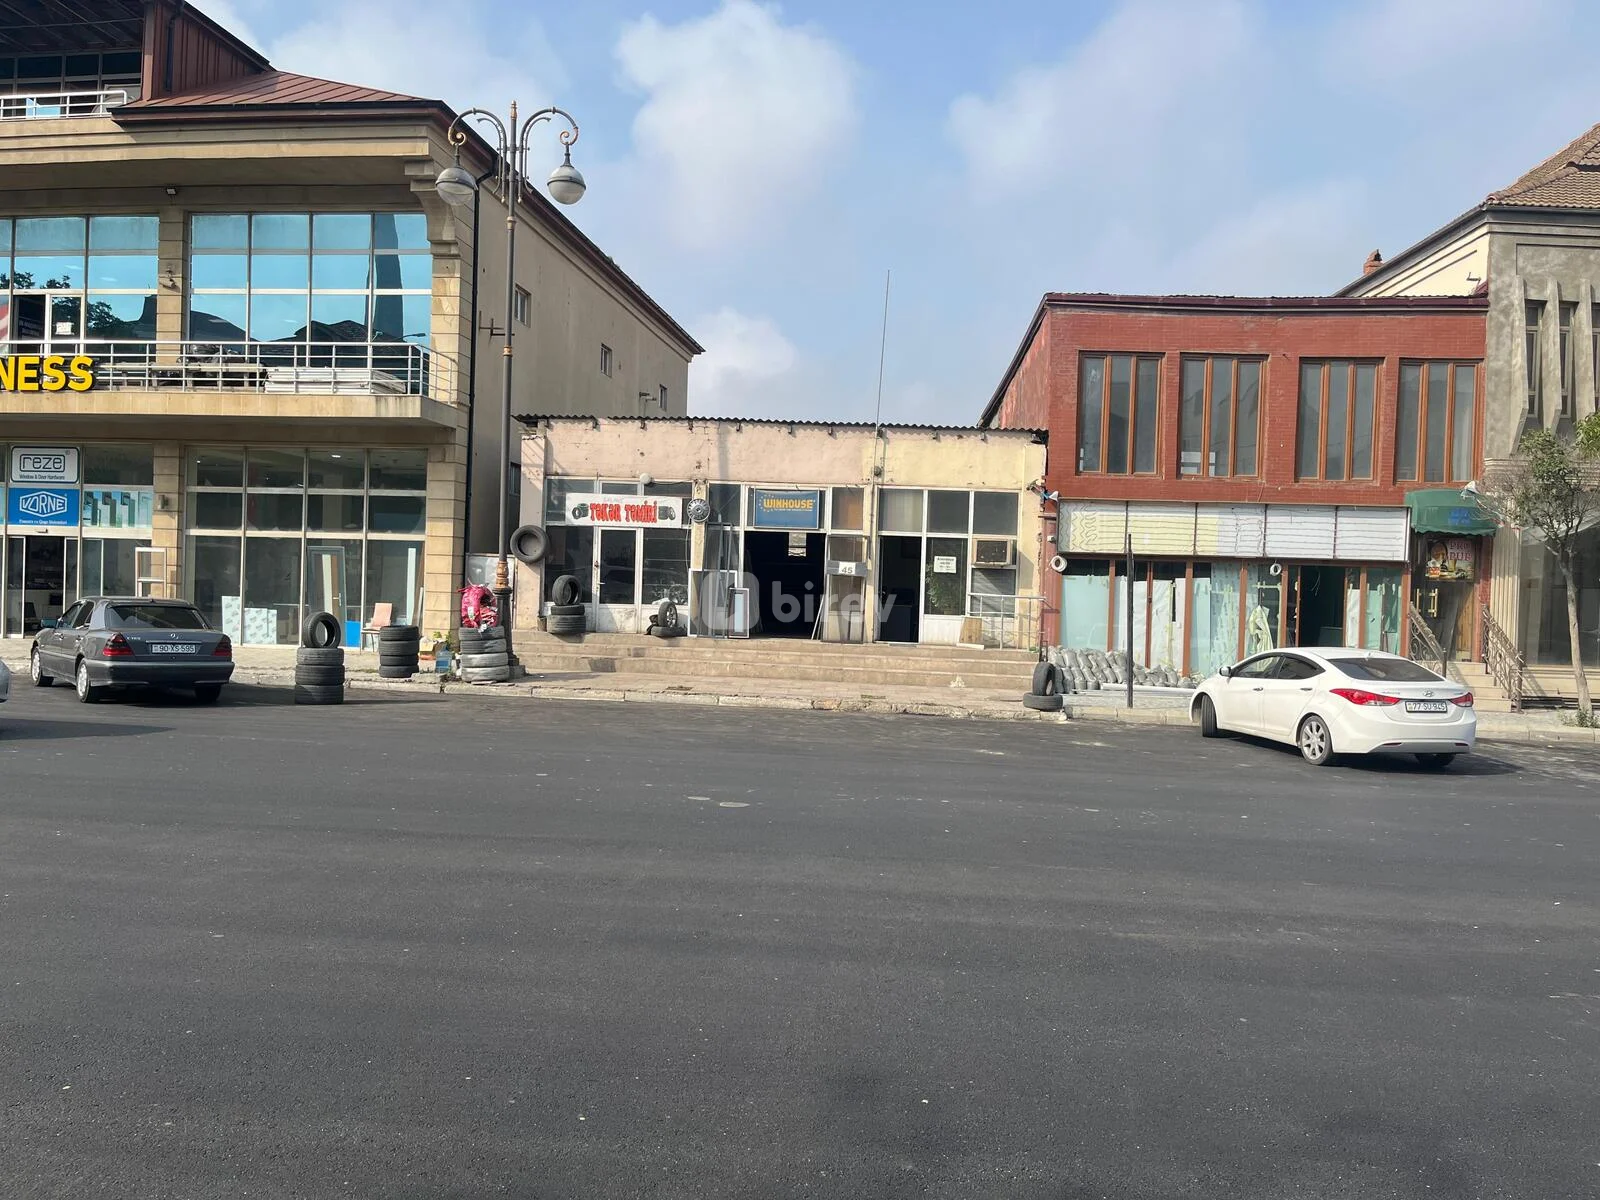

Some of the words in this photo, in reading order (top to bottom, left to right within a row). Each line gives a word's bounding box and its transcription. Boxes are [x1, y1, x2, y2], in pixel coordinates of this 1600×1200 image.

[22, 456, 62, 470] reze
[22, 494, 65, 514] VORNE
[763, 498, 814, 509] WINHOUSE
[841, 566, 853, 574] 45
